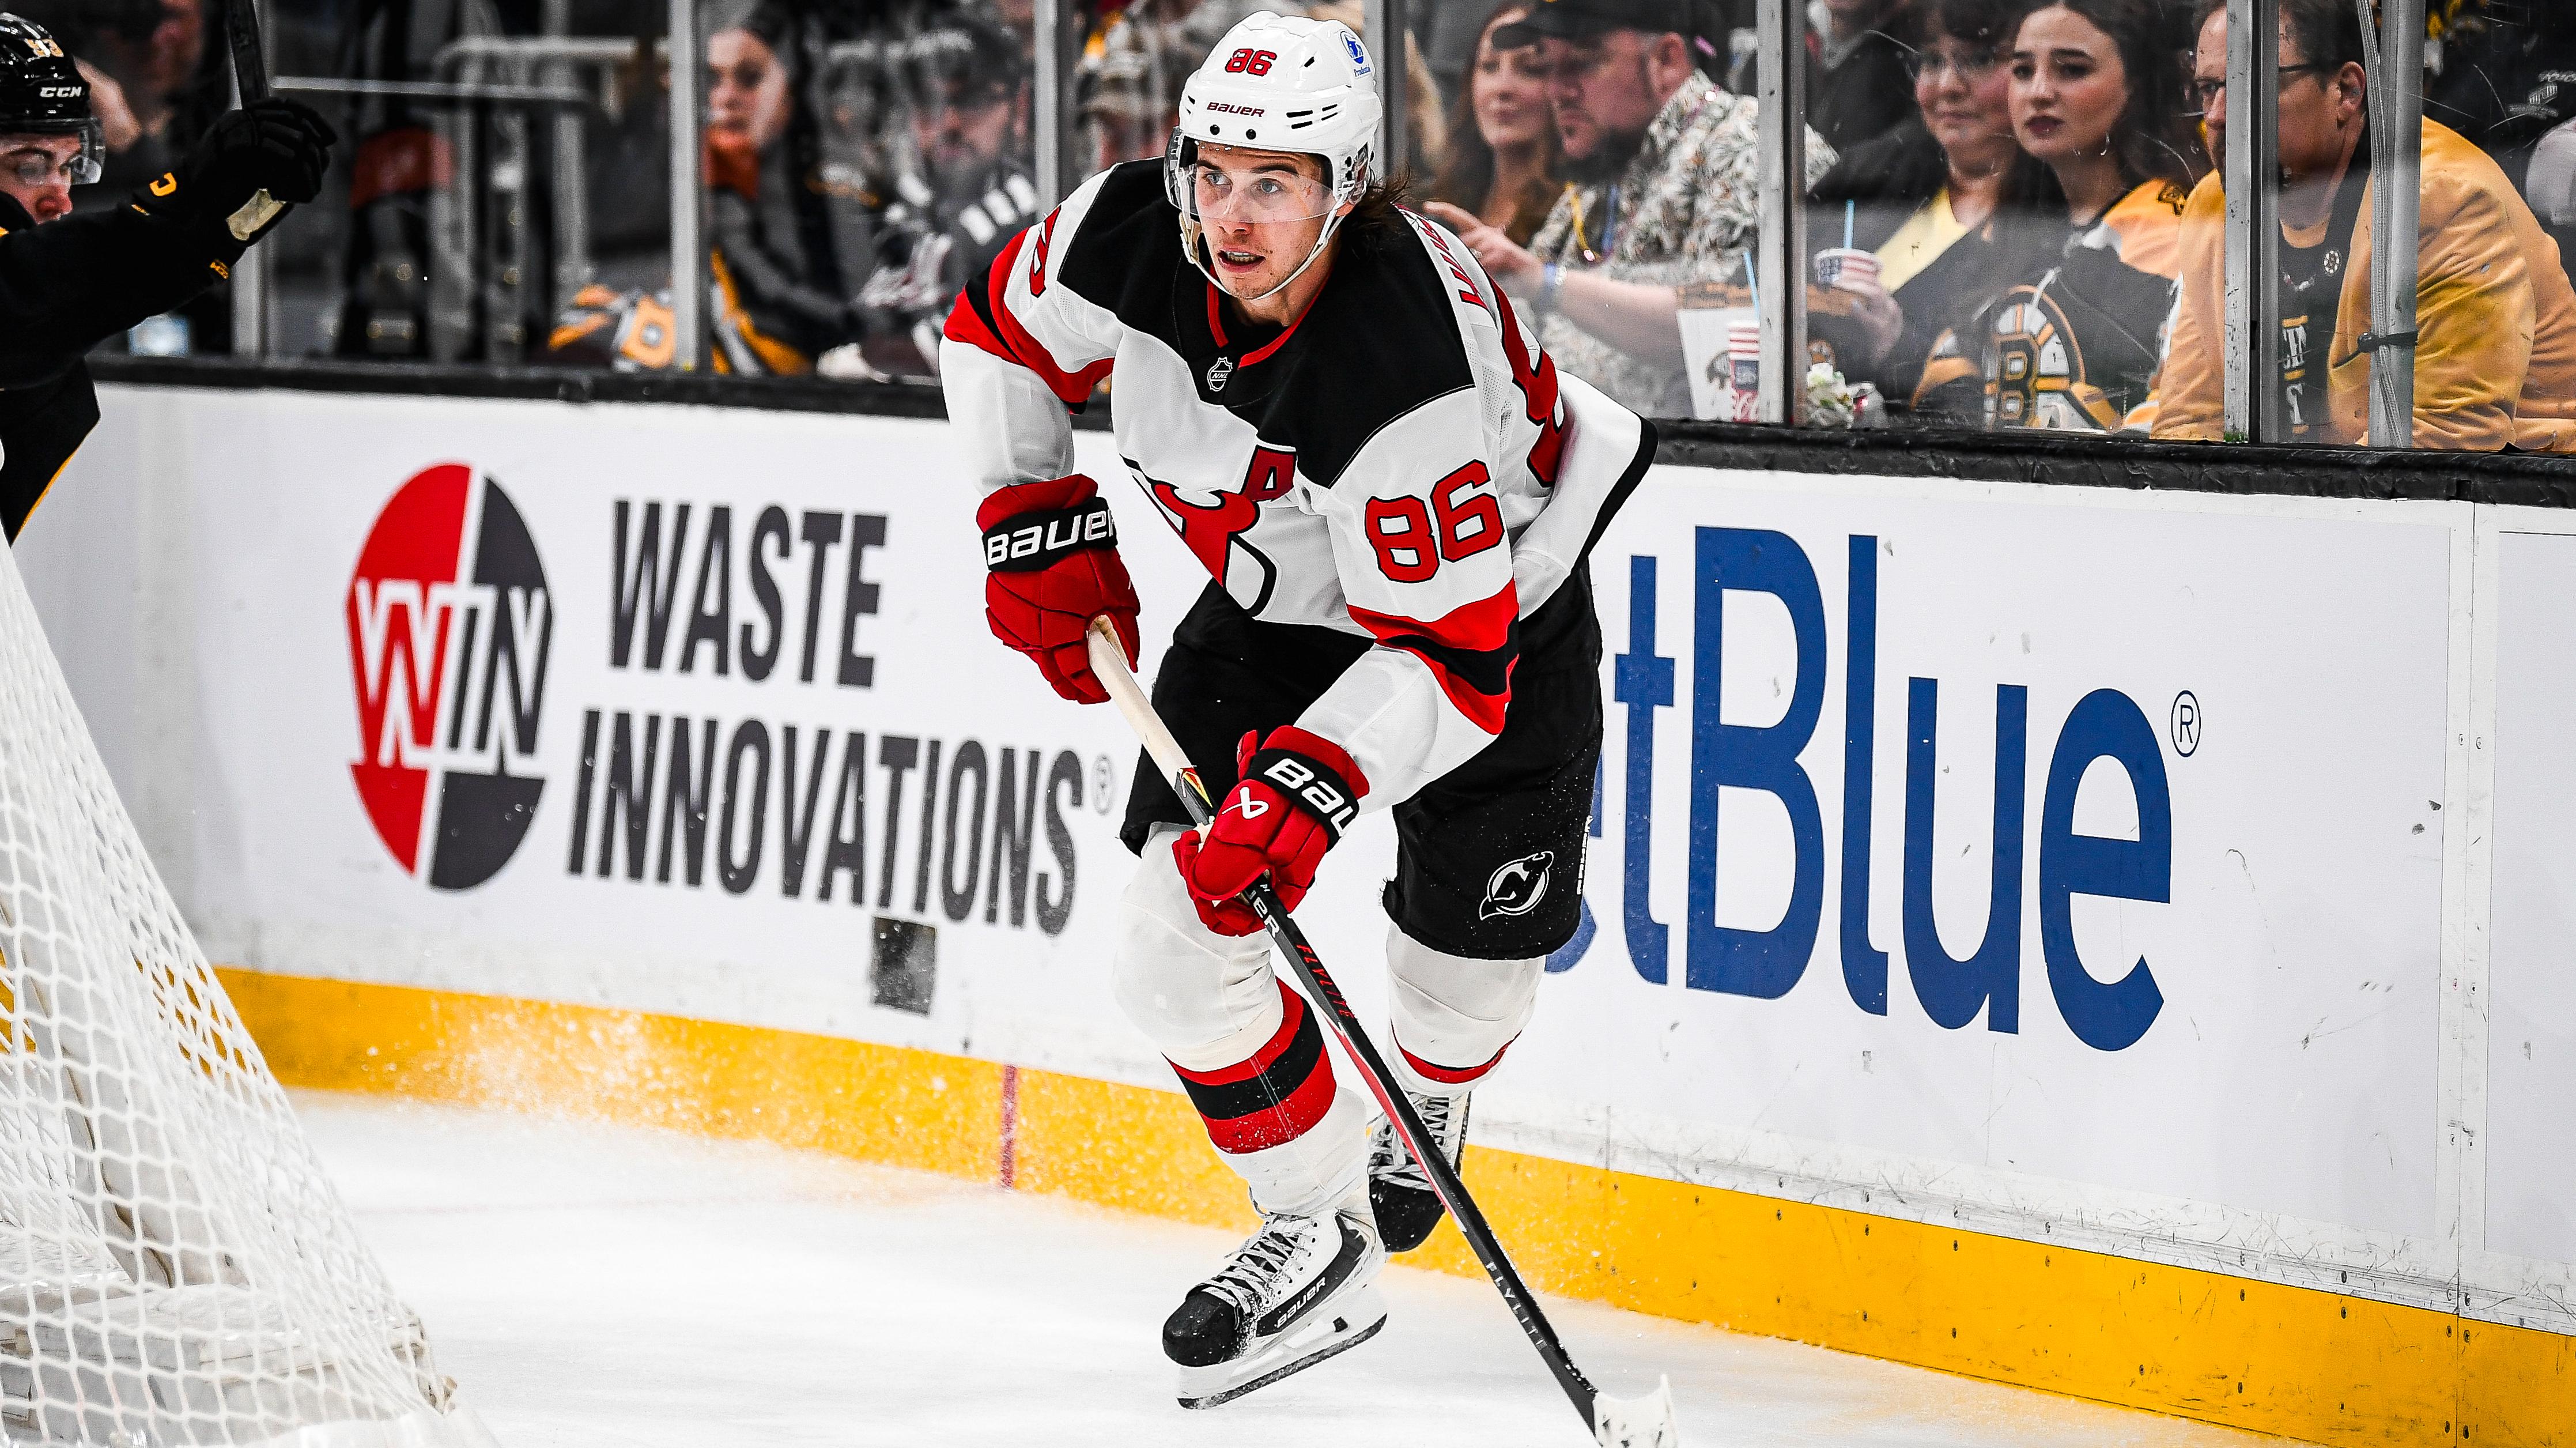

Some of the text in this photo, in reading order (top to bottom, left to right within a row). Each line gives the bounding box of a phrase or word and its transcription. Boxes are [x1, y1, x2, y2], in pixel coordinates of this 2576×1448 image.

[40, 86, 82, 97] CCM
[1225, 48, 1277, 77] 86
[611, 500, 887, 688] WASTE
[1365, 459, 1505, 583] 86
[352, 578, 550, 775] WIN
[568, 708, 1083, 936] INNOVATIONS
[1545, 526, 2171, 1051] tBlue
